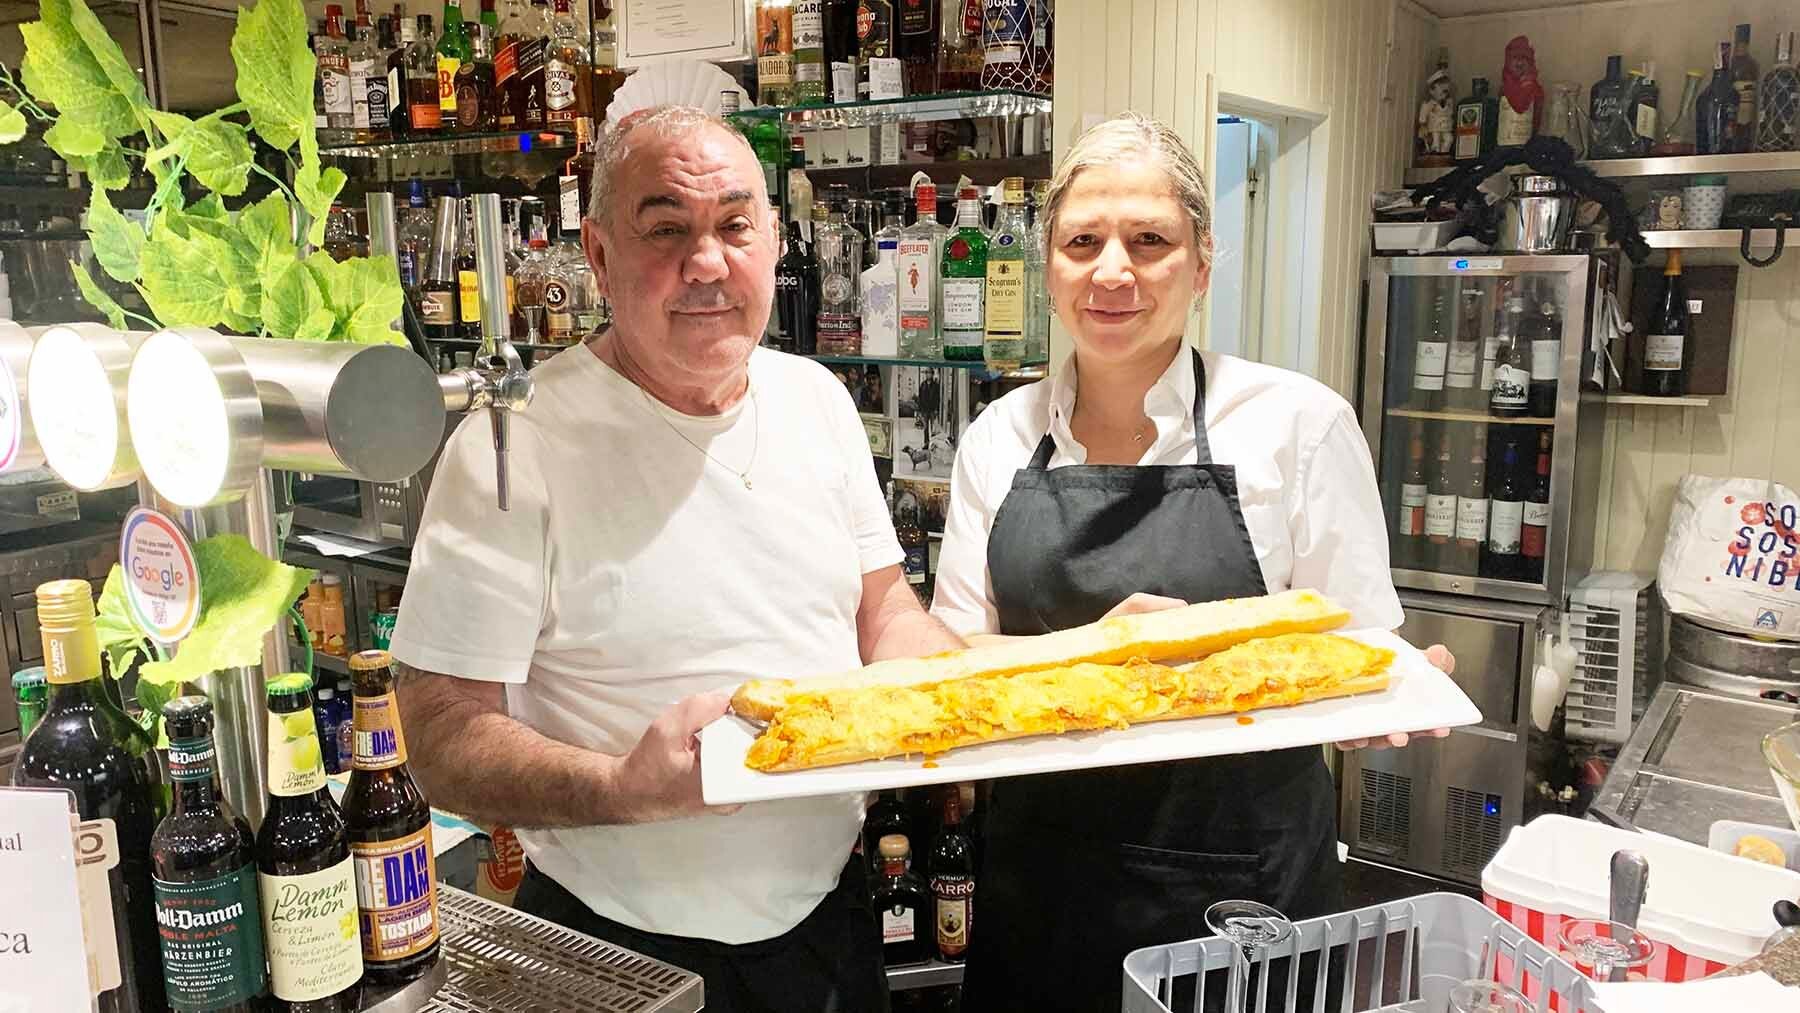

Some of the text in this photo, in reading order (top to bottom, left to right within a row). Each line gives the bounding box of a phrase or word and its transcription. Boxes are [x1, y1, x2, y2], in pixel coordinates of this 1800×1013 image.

[900, 243, 929, 255] BEEFEATER
[988, 276, 1022, 288] Seagram's
[546, 286, 562, 303] 43
[132, 556, 184, 591] Google
[279, 878, 348, 908] Damm
[271, 897, 345, 922] Lemon
